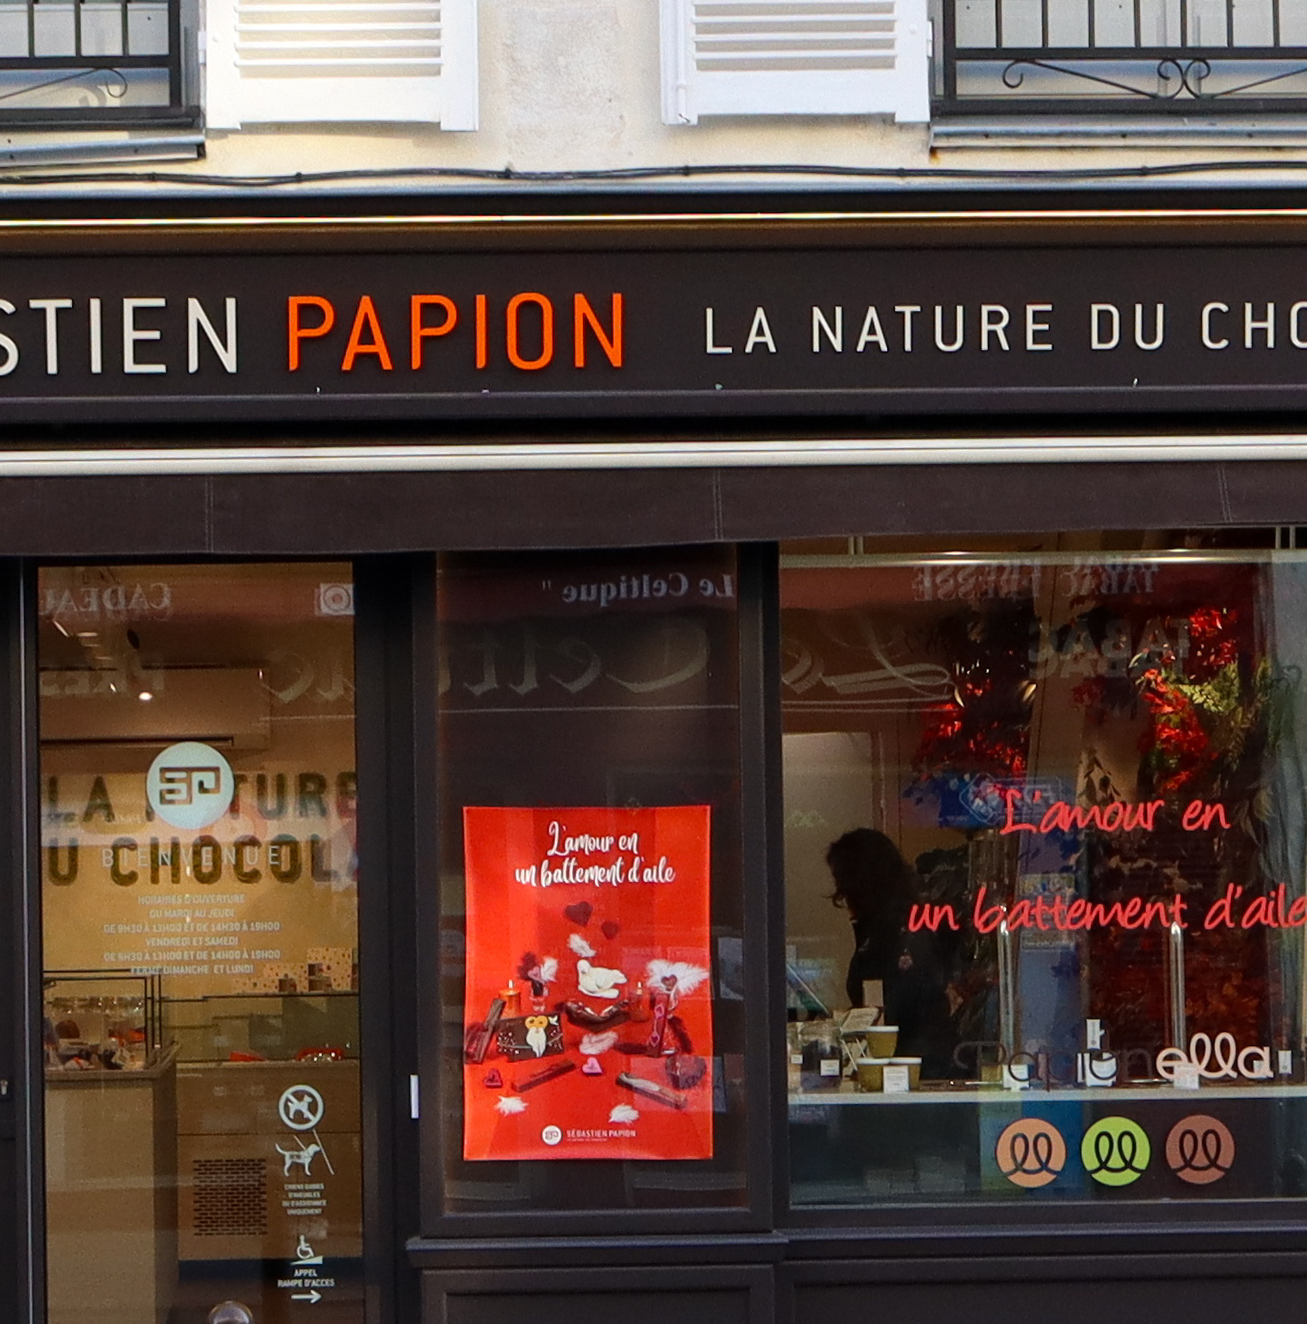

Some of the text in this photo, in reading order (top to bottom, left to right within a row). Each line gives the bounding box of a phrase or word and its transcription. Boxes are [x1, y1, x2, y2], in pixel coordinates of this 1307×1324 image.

[288, 292, 624, 372] PAPION
[705, 306, 777, 354] LA
[812, 304, 1054, 352] NATURE
[1092, 303, 1164, 350] DU
[48, 774, 116, 823] LA
[999, 788, 1166, 835] L'amour
[1182, 800, 1231, 831] en
[101, 846, 281, 868] BIENVENUE
[110, 833, 339, 887] CHOCOL
[546, 821, 639, 856] L'amour en
[515, 865, 537, 886] un
[539, 860, 625, 888] battement
[907, 898, 961, 933] un
[974, 885, 1188, 934] battement
